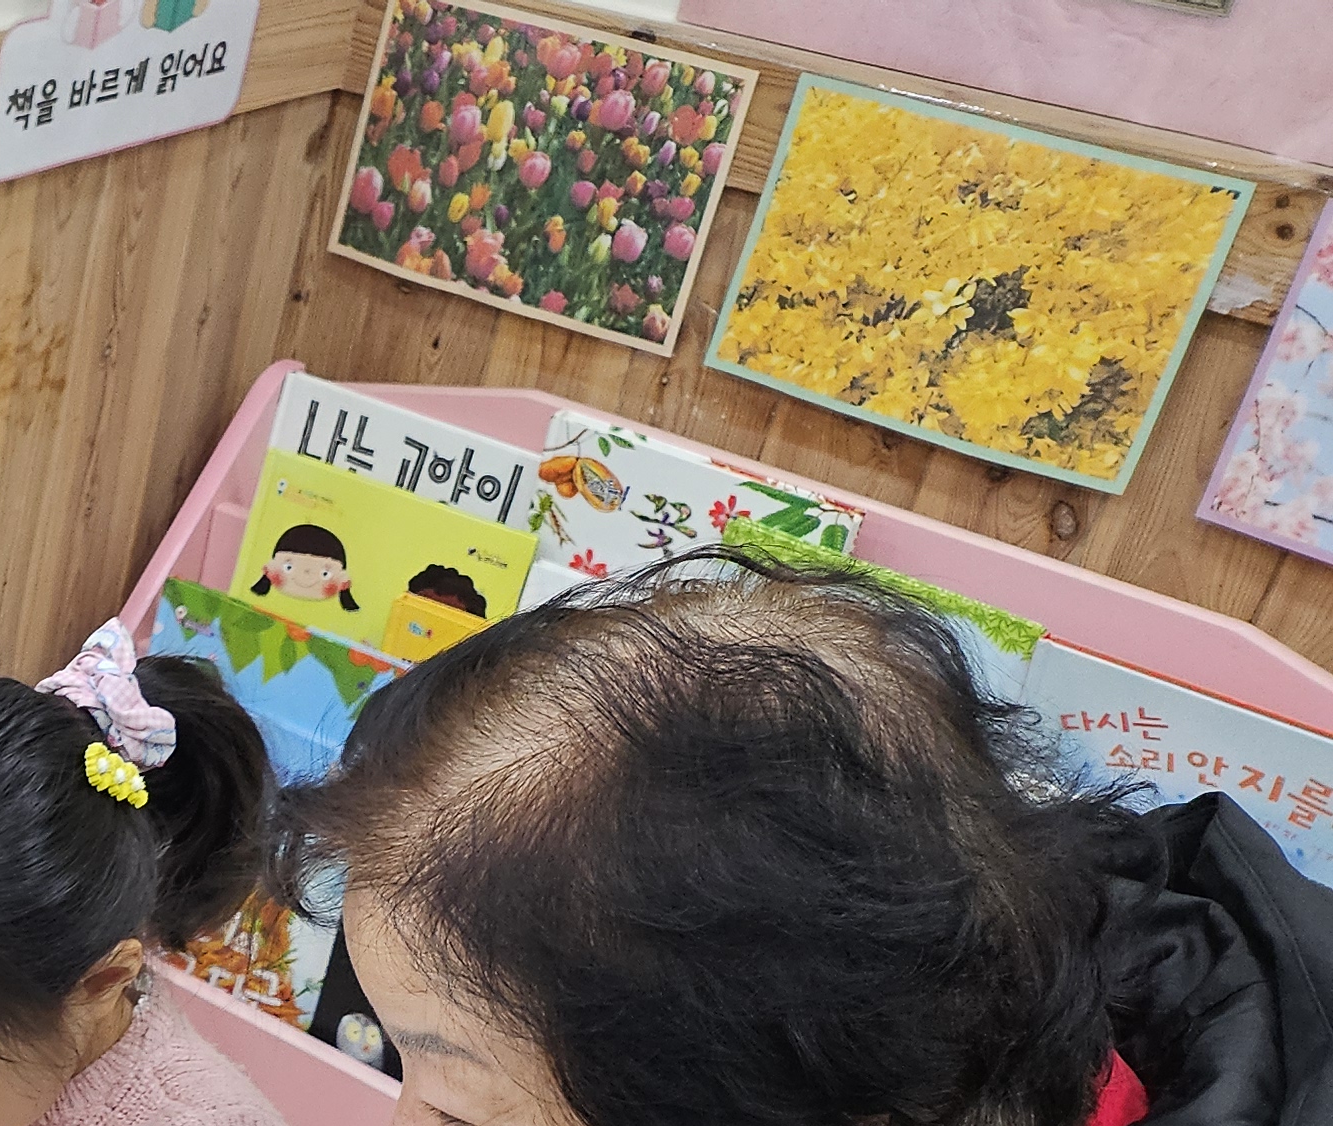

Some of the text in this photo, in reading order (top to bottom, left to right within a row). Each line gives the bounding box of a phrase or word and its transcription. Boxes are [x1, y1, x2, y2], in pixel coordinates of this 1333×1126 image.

[5, 40, 228, 130] 책을 바르게 읽어요
[297, 400, 375, 474] 나는
[1060, 706, 1169, 741] 다시는
[1105, 744, 1176, 773] 소리
[1187, 751, 1229, 788] 안
